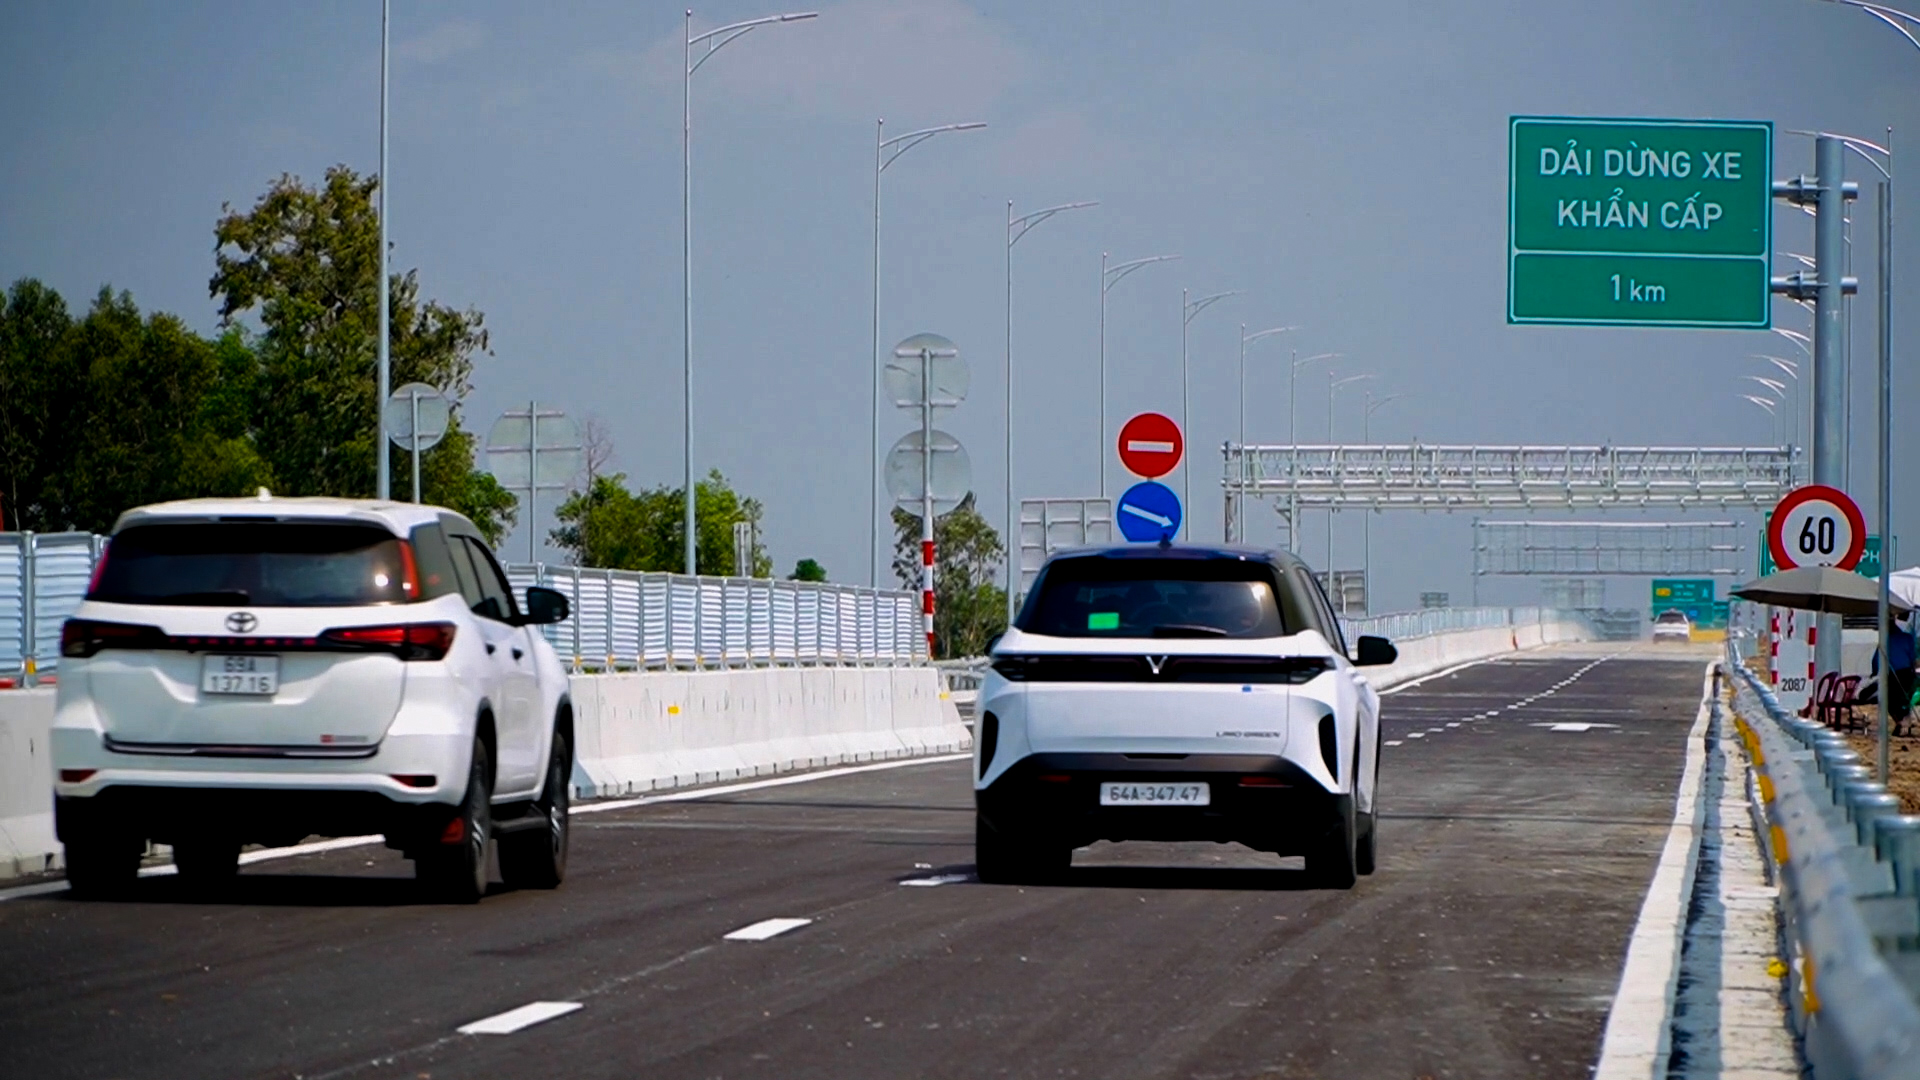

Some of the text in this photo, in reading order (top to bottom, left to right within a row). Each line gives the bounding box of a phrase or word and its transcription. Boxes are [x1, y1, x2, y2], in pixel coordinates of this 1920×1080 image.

[1540, 139, 1741, 179] DẢI DỪNG XE
[1558, 187, 1723, 230] KHẨN CẤP
[1610, 274, 1665, 302] 1 km
[1799, 516, 1835, 554] 60
[1109, 786, 1200, 801] 64A-347.47
